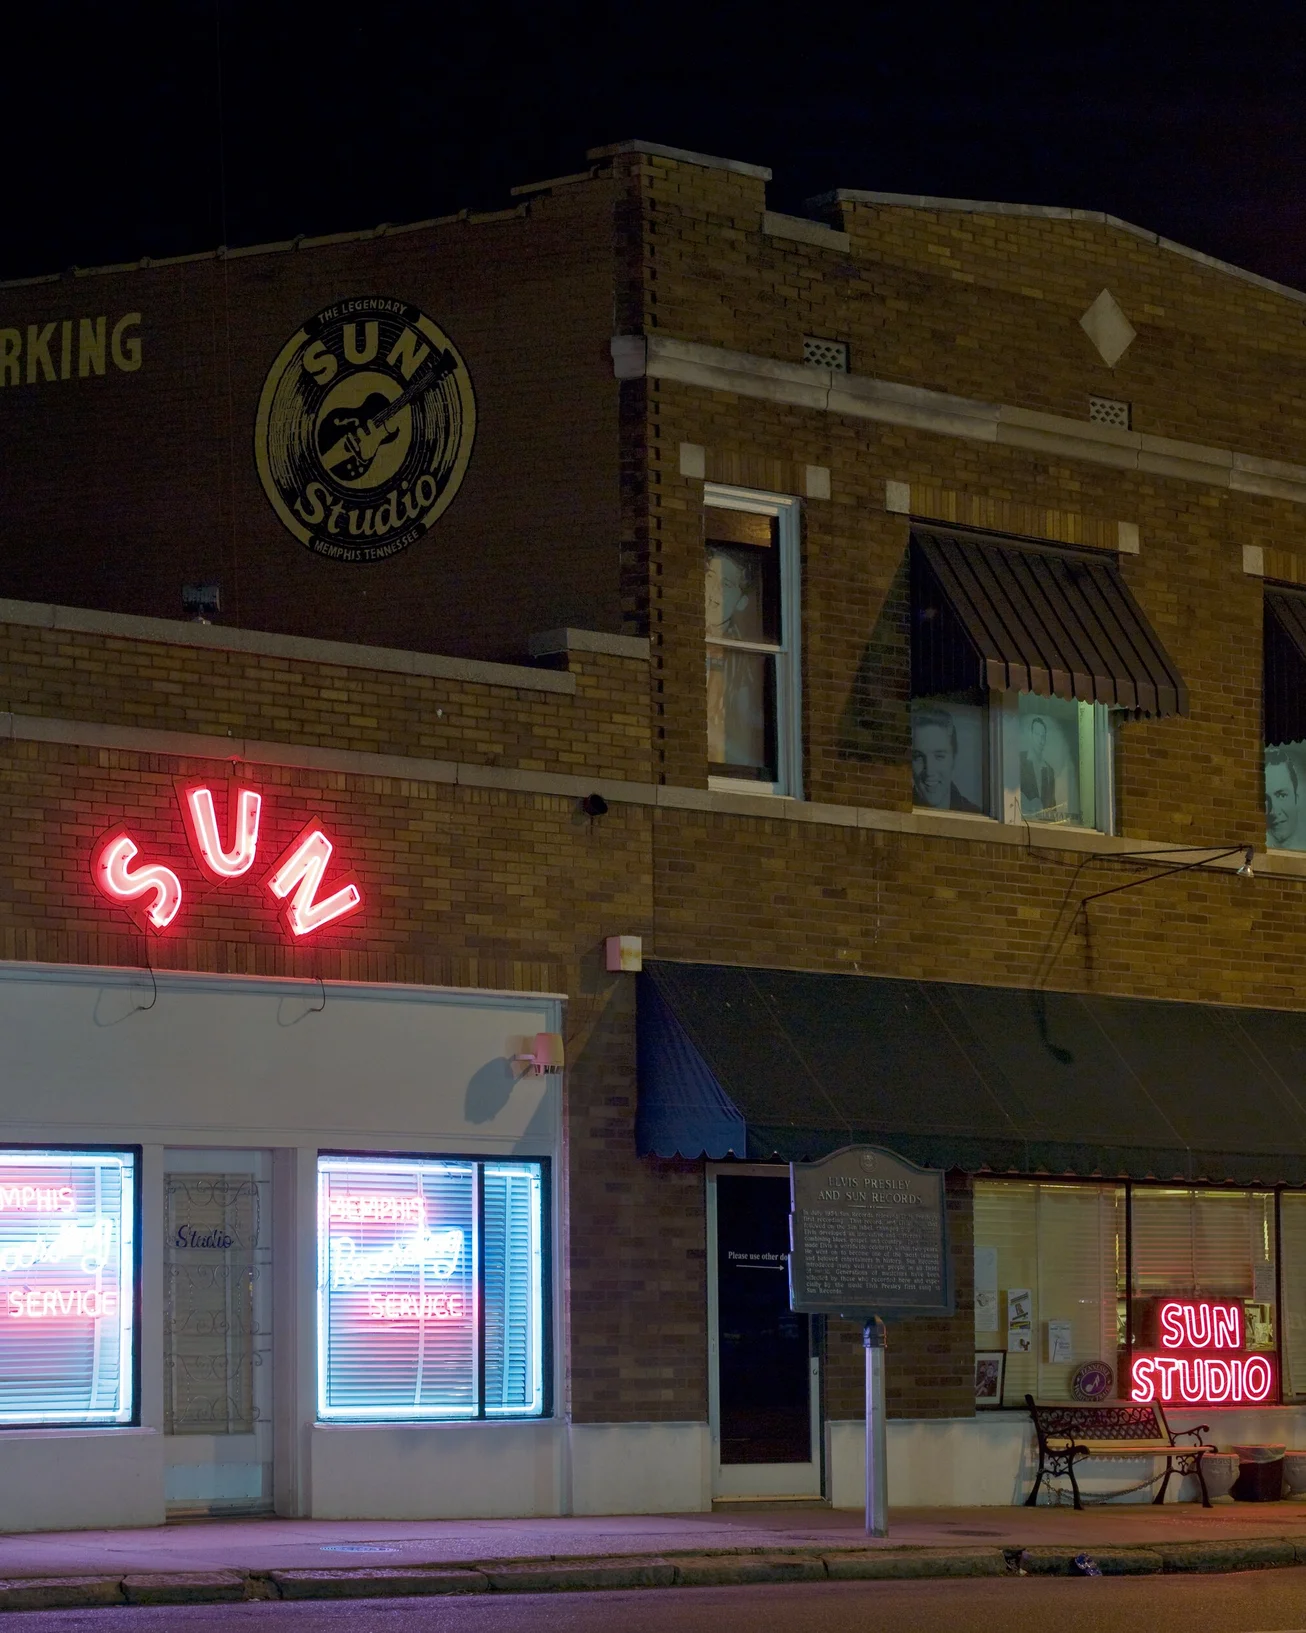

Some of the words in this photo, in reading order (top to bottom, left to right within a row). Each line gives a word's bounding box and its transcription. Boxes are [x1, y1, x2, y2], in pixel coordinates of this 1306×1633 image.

[318, 307, 339, 325] THE
[342, 299, 408, 315] LEGENDARY
[0, 312, 142, 387] RKING
[303, 321, 432, 386] SUN
[294, 474, 437, 536] Studio
[314, 539, 362, 561] MEMPHIS
[364, 529, 420, 560] TENNESSEE
[97, 784, 362, 937] SUN
[819, 1190, 840, 1200] AND
[845, 1191, 866, 1202] SUN
[872, 1192, 923, 1204] RECORDS
[828, 1176, 859, 1188] ELVIS
[864, 1178, 911, 1190] PRESLEY
[175, 1223, 235, 1249] Studio
[728, 1251, 749, 1260] Please
[761, 1252, 779, 1261] other
[8, 1289, 118, 1318] SERVICE
[369, 1293, 464, 1319] SERVICE
[1161, 1302, 1240, 1349] SUN
[1130, 1356, 1272, 1403] STUDIO
